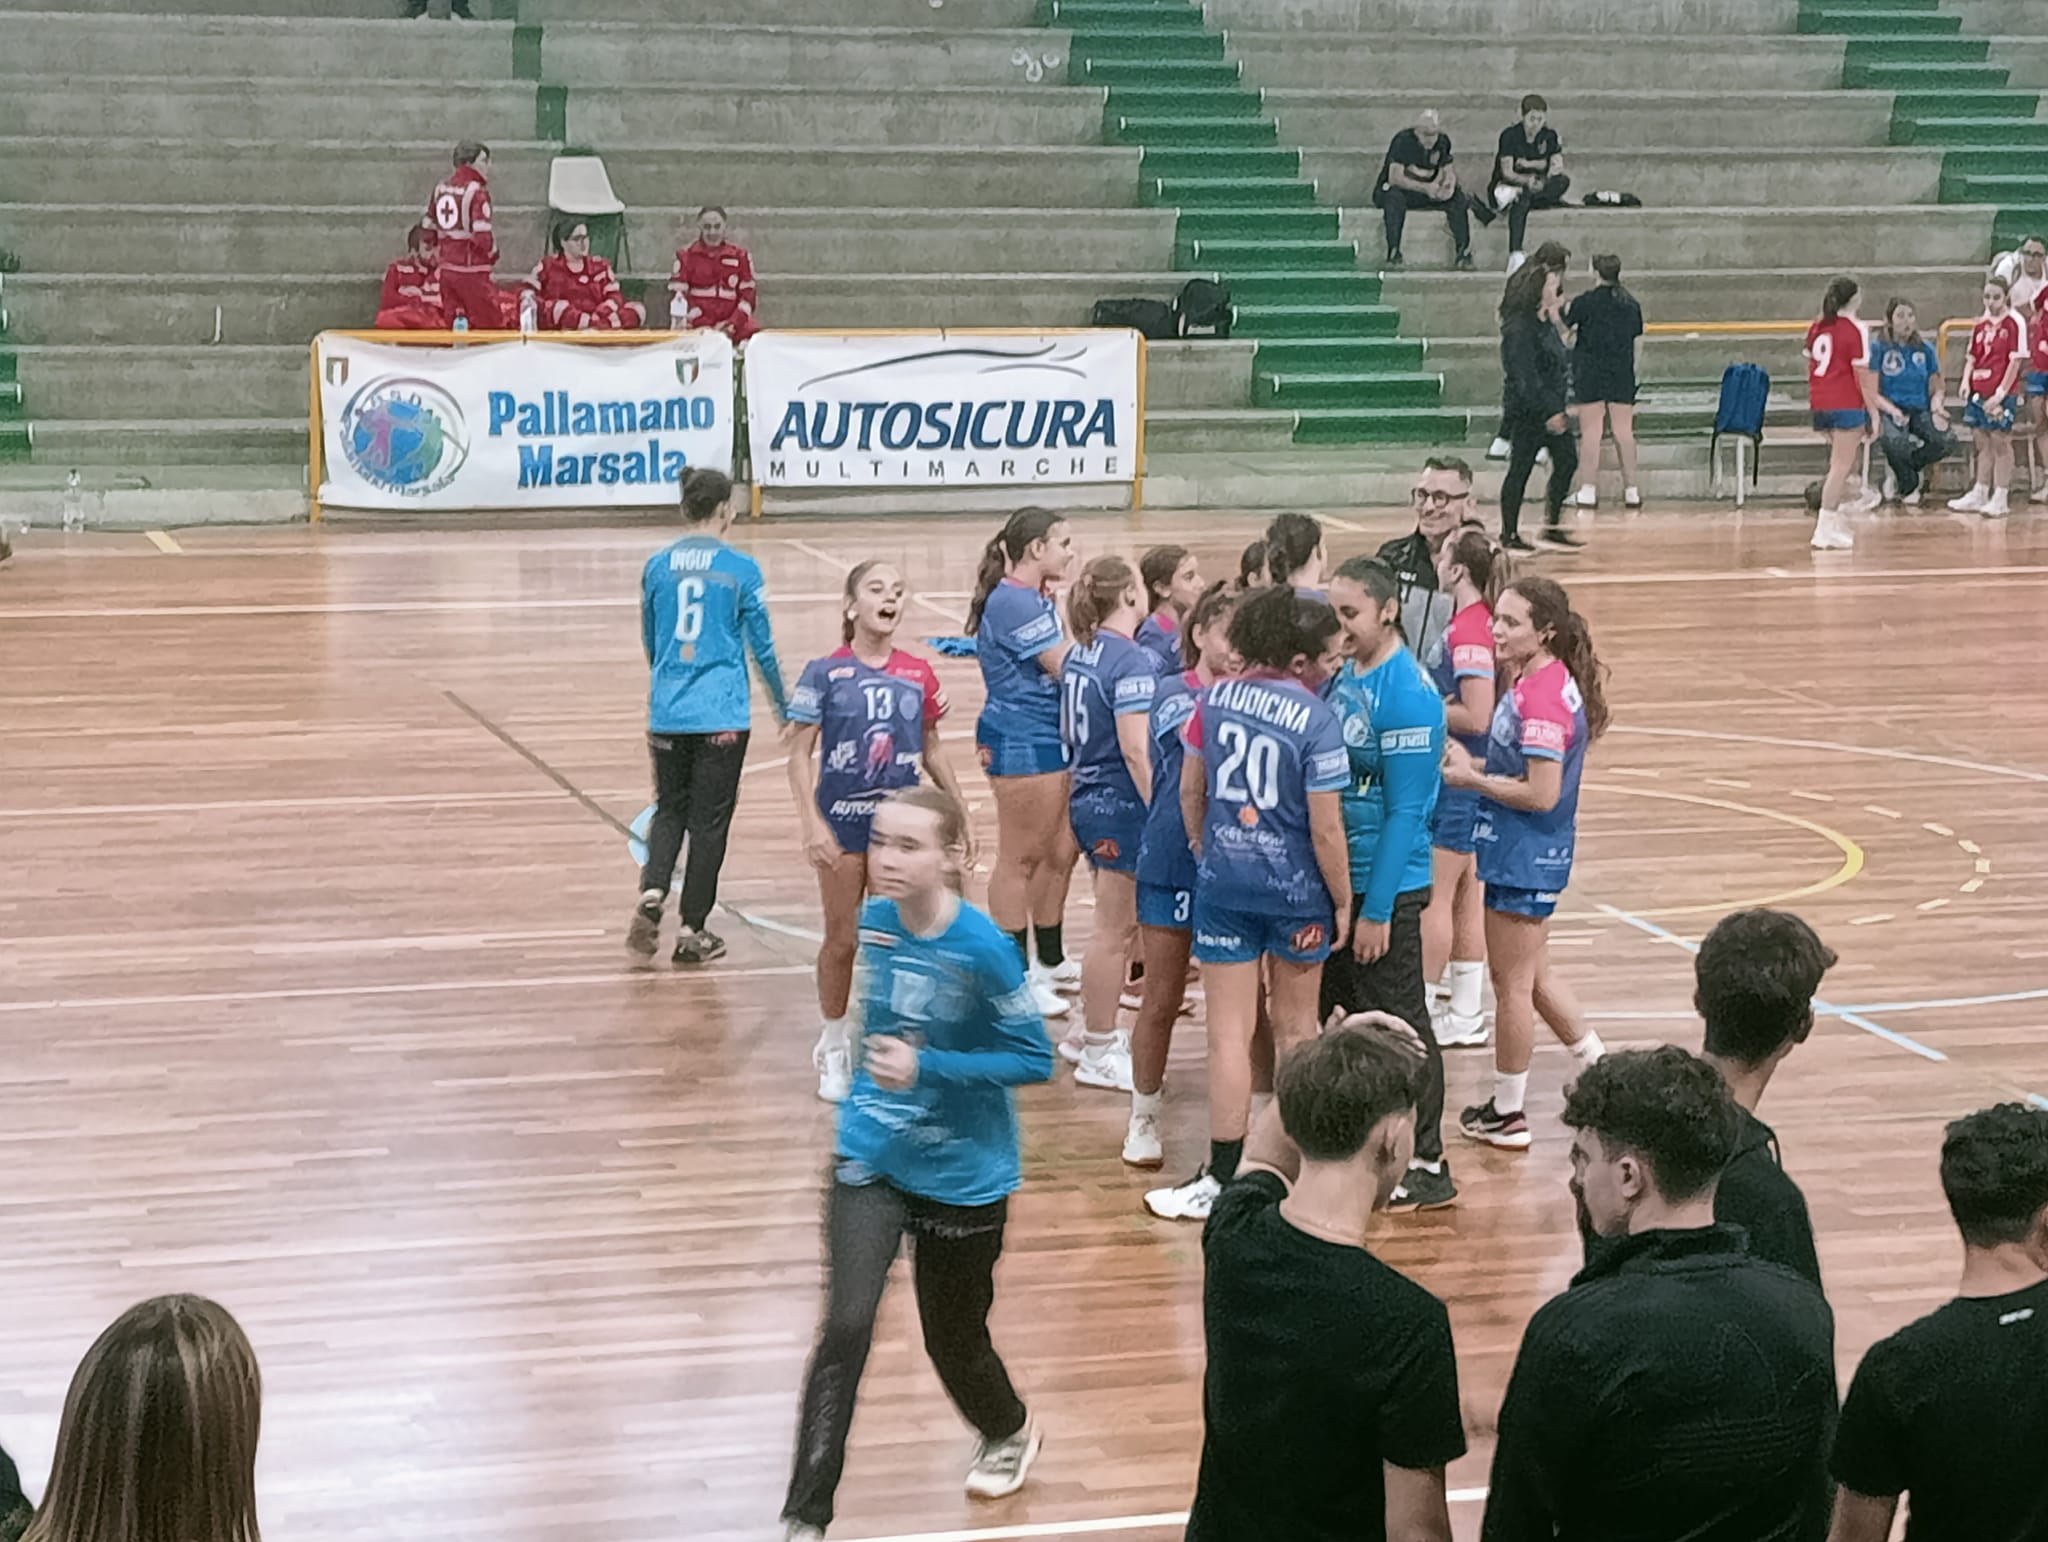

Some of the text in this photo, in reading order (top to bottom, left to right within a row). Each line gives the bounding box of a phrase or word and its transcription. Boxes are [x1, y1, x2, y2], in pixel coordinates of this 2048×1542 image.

[1811, 333, 1833, 376] 9
[487, 391, 715, 437] Pallamano
[769, 399, 1118, 451] AUTOSICURA
[517, 439, 686, 489] Marsala
[769, 456, 1118, 479] MULTIMARCHE
[675, 577, 704, 642] 6
[863, 686, 893, 721] 13
[1064, 672, 1090, 746] 15
[1207, 679, 1312, 734] LAUDICINA
[1215, 721, 1279, 811] 20
[830, 800, 876, 816] AUTOS
[1173, 890, 1190, 922] 3
